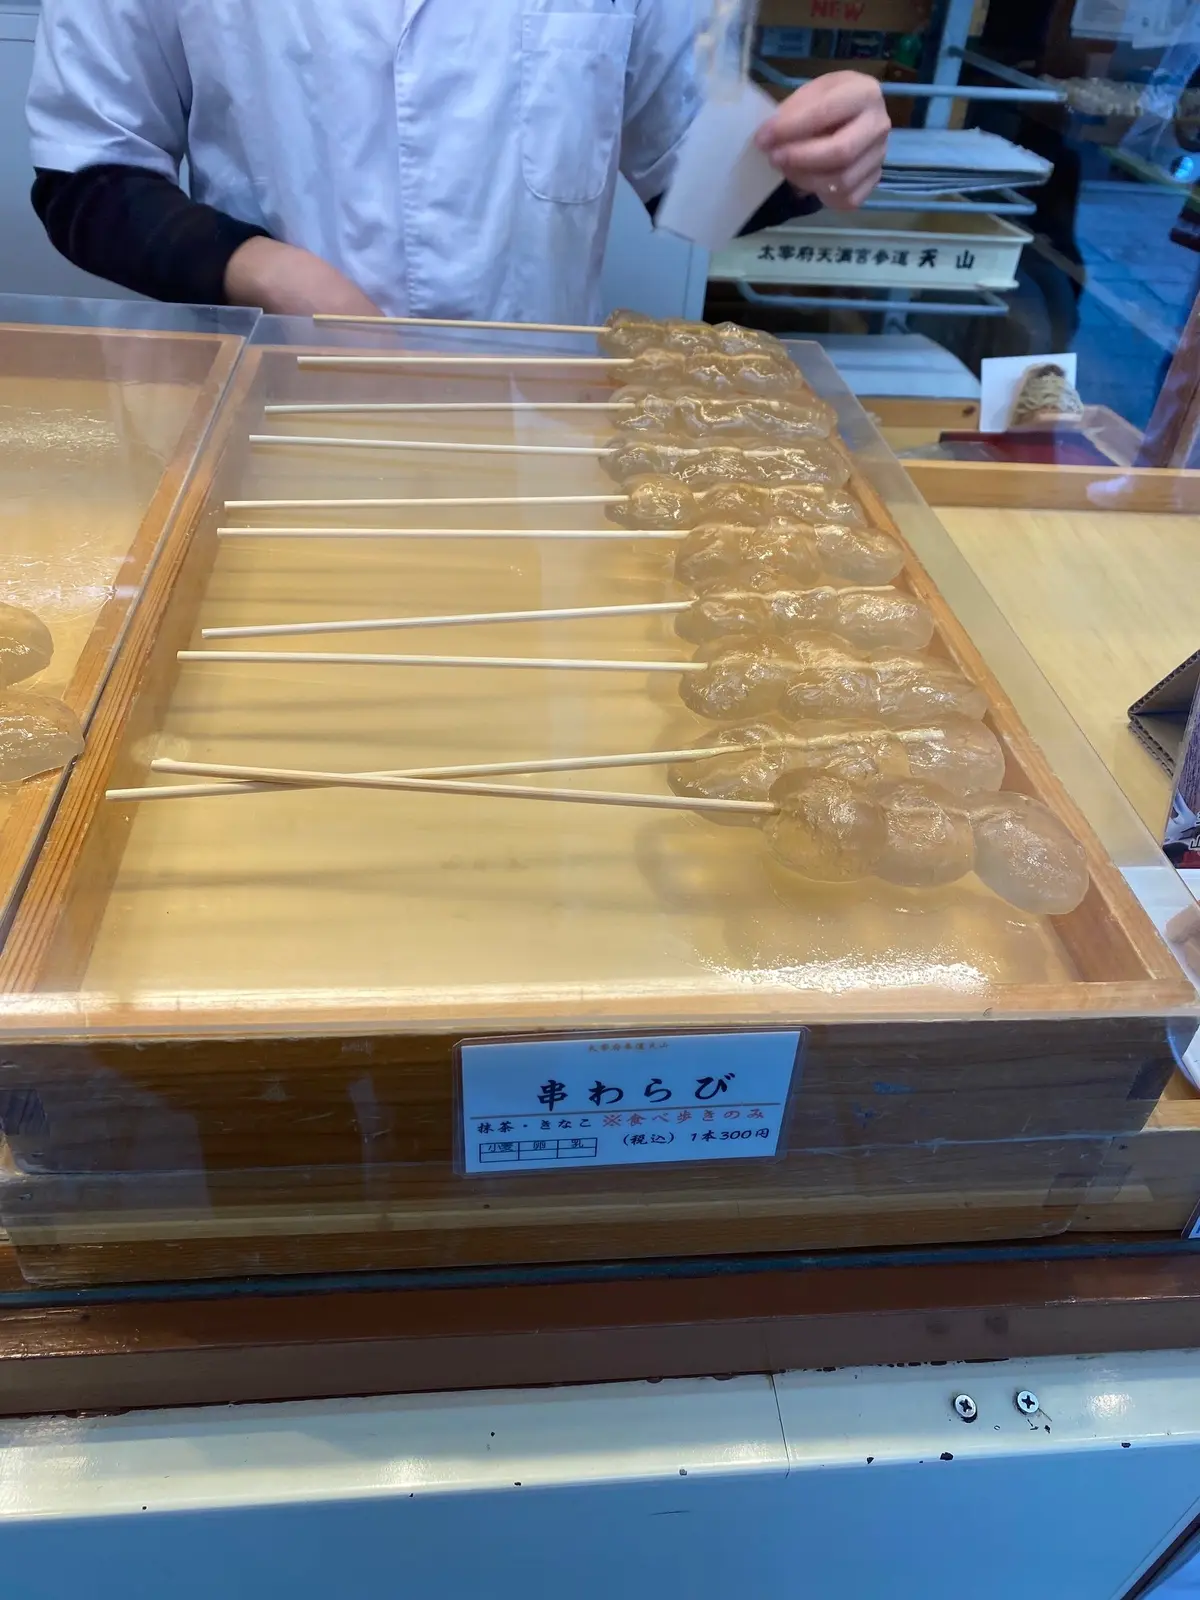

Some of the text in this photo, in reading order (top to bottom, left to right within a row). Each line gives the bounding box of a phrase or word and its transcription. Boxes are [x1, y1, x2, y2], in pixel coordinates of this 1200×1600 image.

[536, 1072, 736, 1112] 串わらび
[477, 1118, 592, 1134] 抹茶・きなこ
